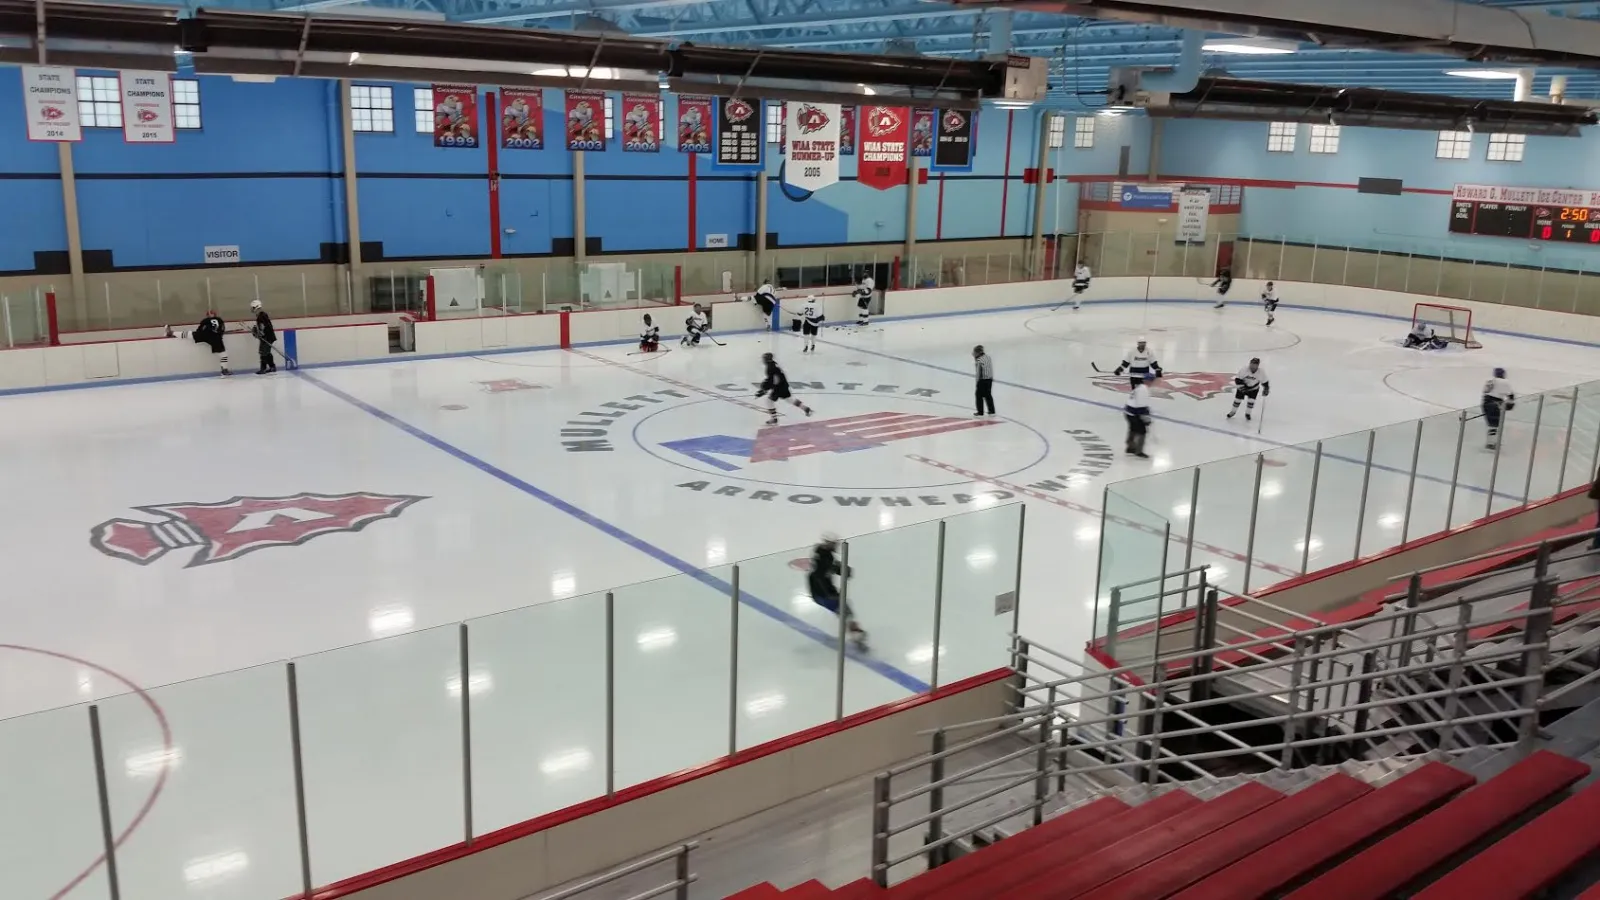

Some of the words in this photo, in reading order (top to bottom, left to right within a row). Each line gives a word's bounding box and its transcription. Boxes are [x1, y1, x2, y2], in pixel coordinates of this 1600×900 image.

[30, 86, 71, 95] CHAMPIONS
[439, 136, 475, 146] 1999
[506, 137, 540, 148] 2002
[570, 140, 603, 150] 2003
[791, 141, 810, 151] WIAA
[812, 141, 835, 151] STATE
[626, 142, 656, 151] 2004
[681, 143, 709, 152] 2005
[863, 142, 881, 151] WIAA
[882, 142, 904, 152] STATE
[791, 151, 835, 161] RUNNER-UP
[863, 152, 904, 162] CHAMPIONS
[804, 167, 821, 177] 2005
[1500, 188, 1535, 202] MULLETT
[1552, 190, 1583, 205] CENTER
[1560, 208, 1588, 221] 2:50
[1542, 225, 1552, 239] 0
[1566, 229, 1572, 238] 1
[206, 250, 239, 258] VISITOR
[804, 307, 814, 316] 25
[560, 389, 690, 452] MULLETT
[674, 480, 1015, 507] ARROWHEAD
